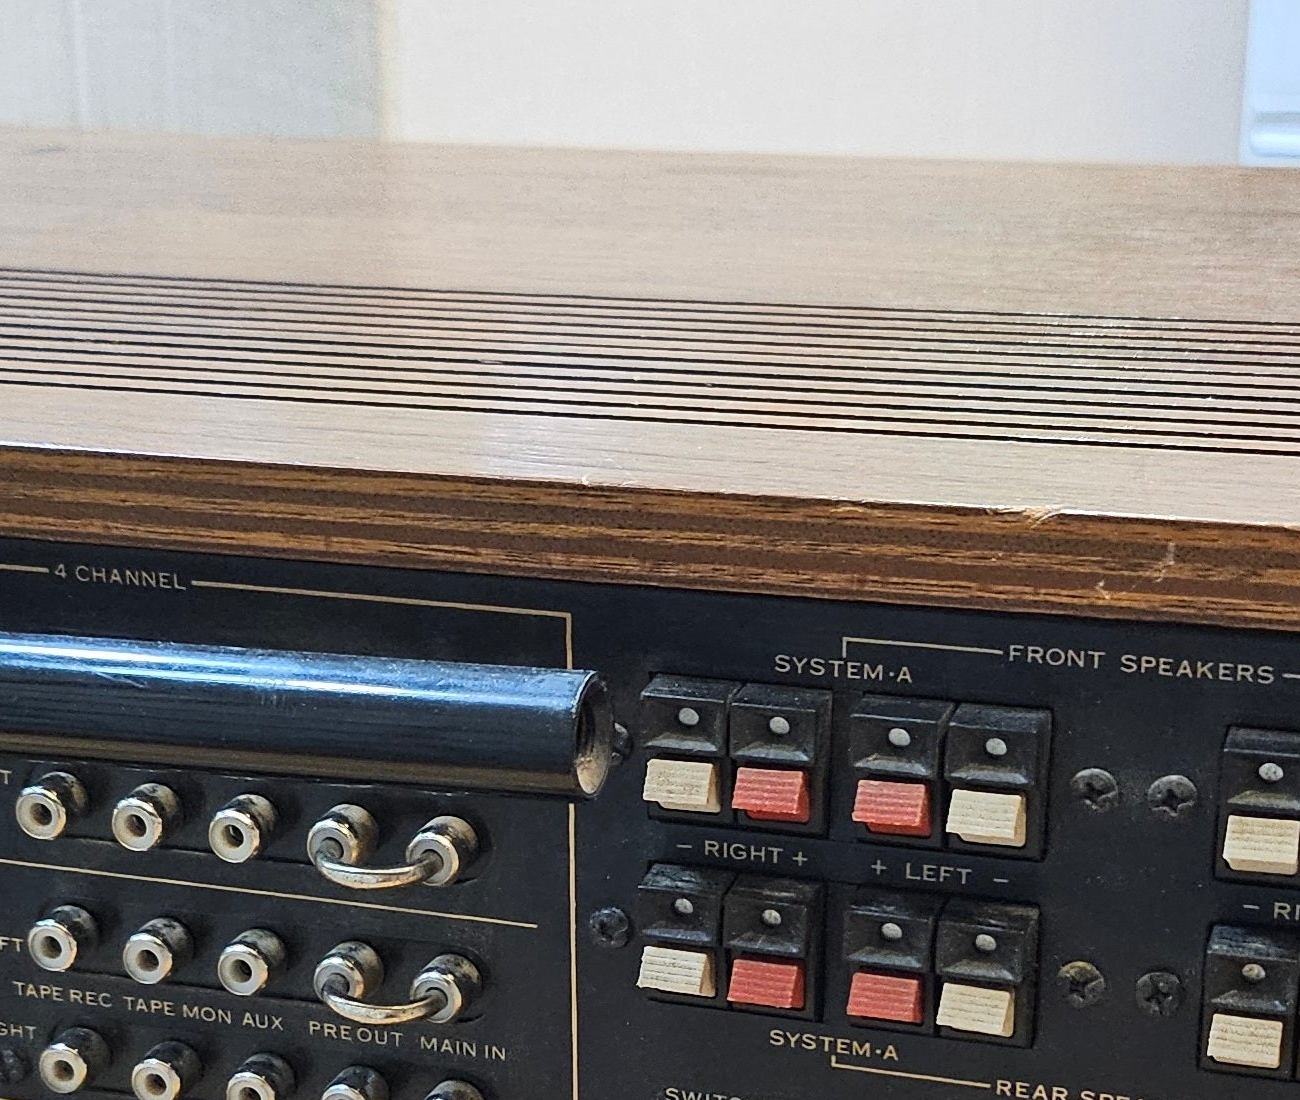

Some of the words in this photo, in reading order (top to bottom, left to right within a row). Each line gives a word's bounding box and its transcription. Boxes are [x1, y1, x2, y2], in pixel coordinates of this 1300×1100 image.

[54, 563, 67, 580] 4
[75, 565, 187, 591] CHANNEL
[1008, 643, 1106, 670] FRONT
[1119, 653, 1276, 686] SPEAKERS
[704, 840, 783, 865] RIGHT
[906, 863, 972, 885] LEFT
[13, 981, 64, 1001] TAPE
[70, 992, 113, 1008] REC
[123, 996, 175, 1017] TAPE
[183, 1004, 232, 1024] MON
[243, 1012, 284, 1031] AUX
[420, 1036, 477, 1056] MAIN
[484, 1043, 506, 1061] IN
